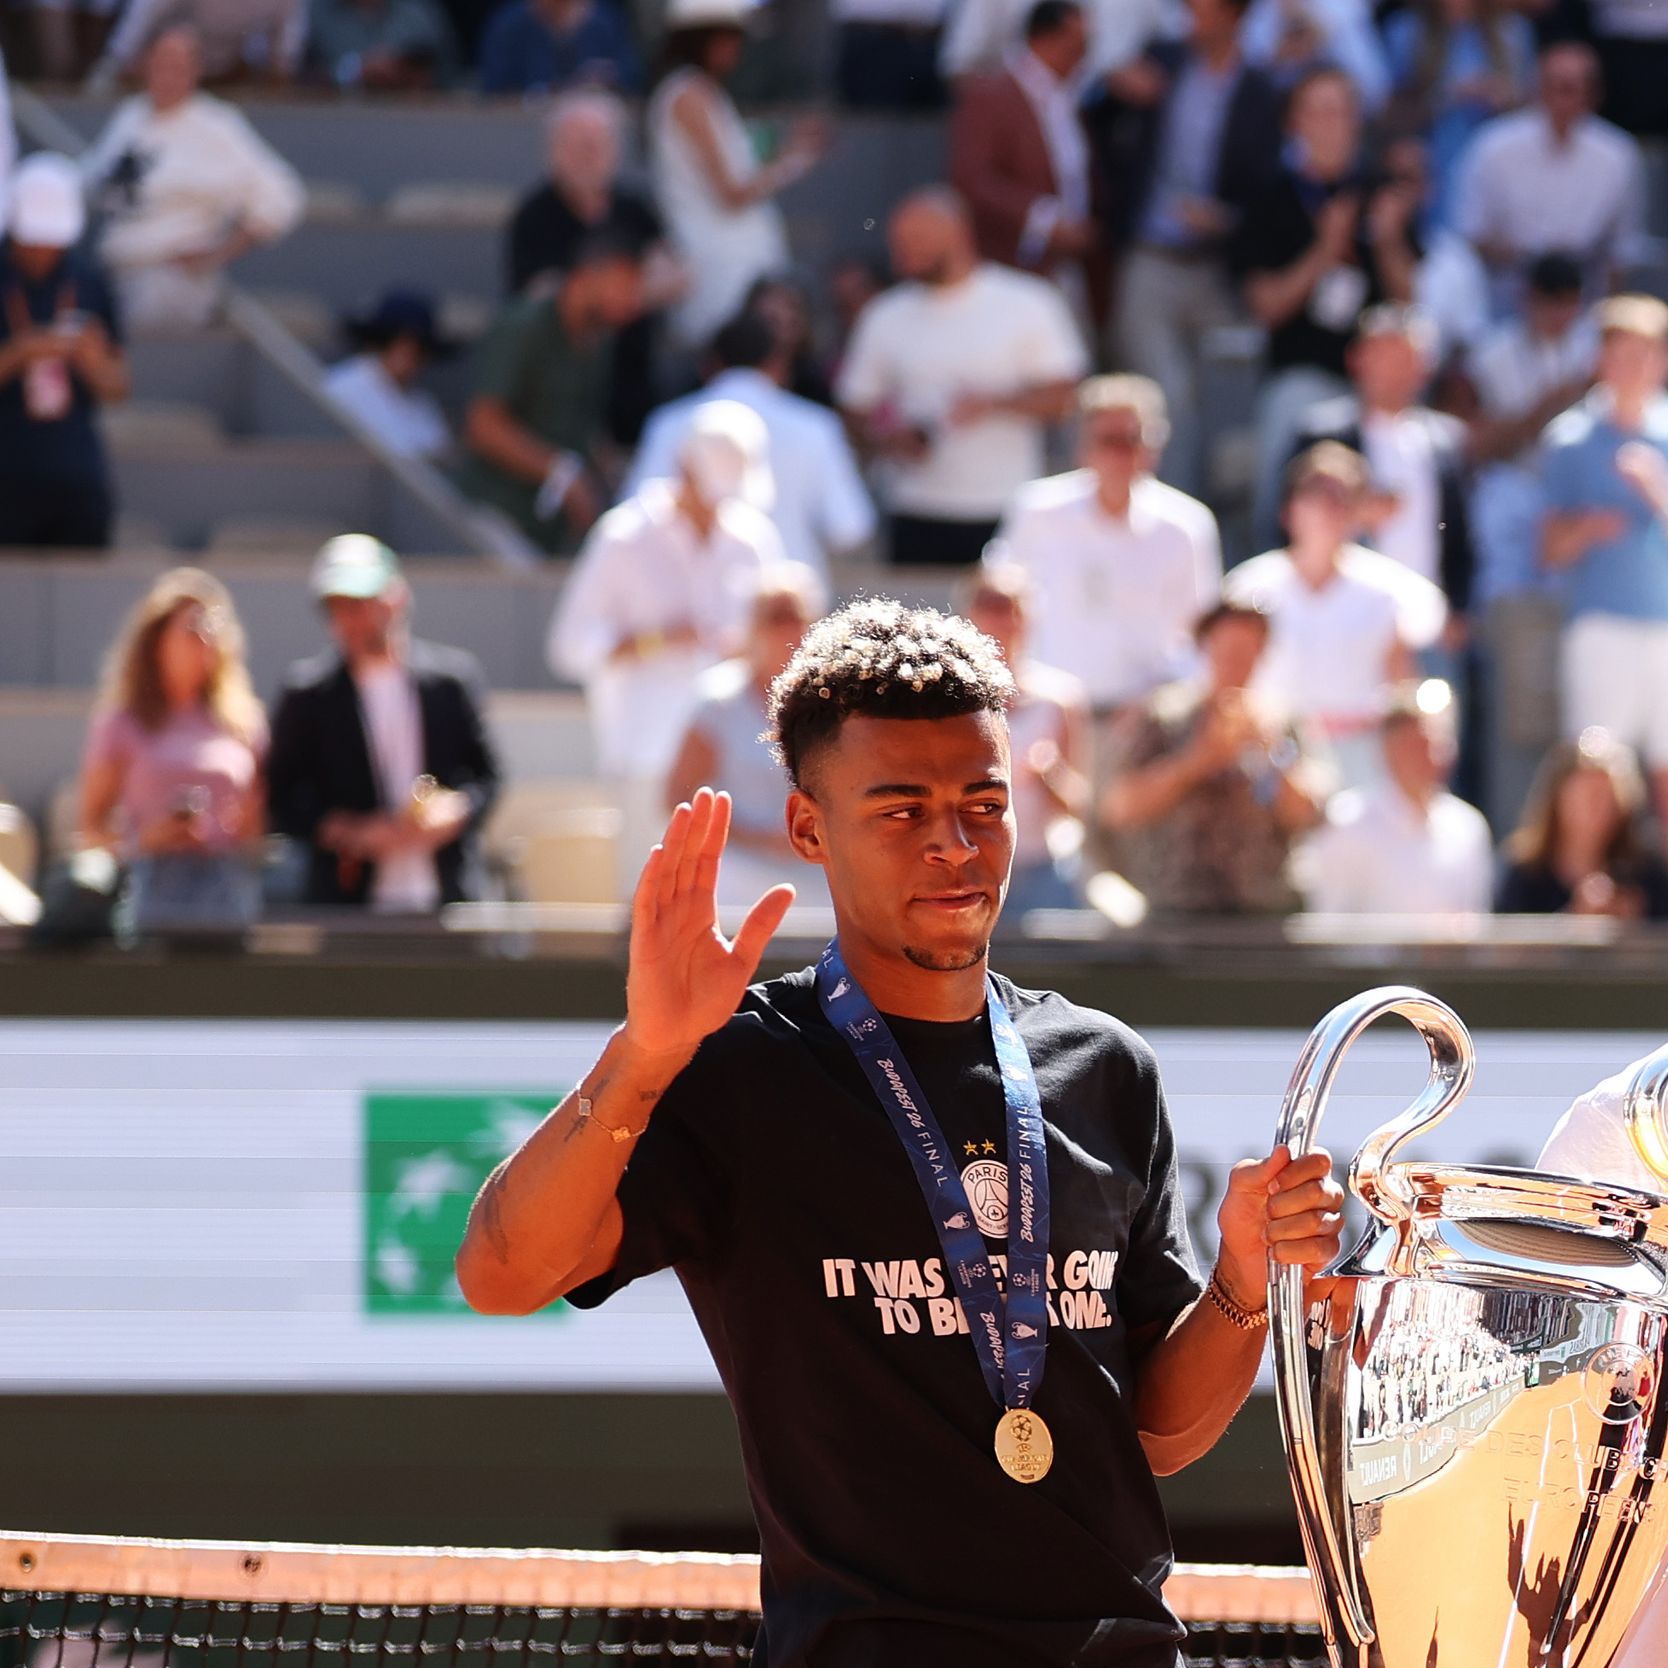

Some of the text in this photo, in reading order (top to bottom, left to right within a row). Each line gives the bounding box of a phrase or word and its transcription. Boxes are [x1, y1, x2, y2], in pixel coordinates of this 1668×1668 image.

[877, 1058, 917, 1112] BUDAPEST
[917, 1131, 951, 1188] FINAL
[1017, 1105, 1032, 1160] FINAL
[967, 1166, 1008, 1185] PARIS
[1019, 1178, 1035, 1243] BUDAPEST
[822, 1258, 857, 1298] IT
[861, 1257, 946, 1299] WAS
[873, 1297, 921, 1335] TO
